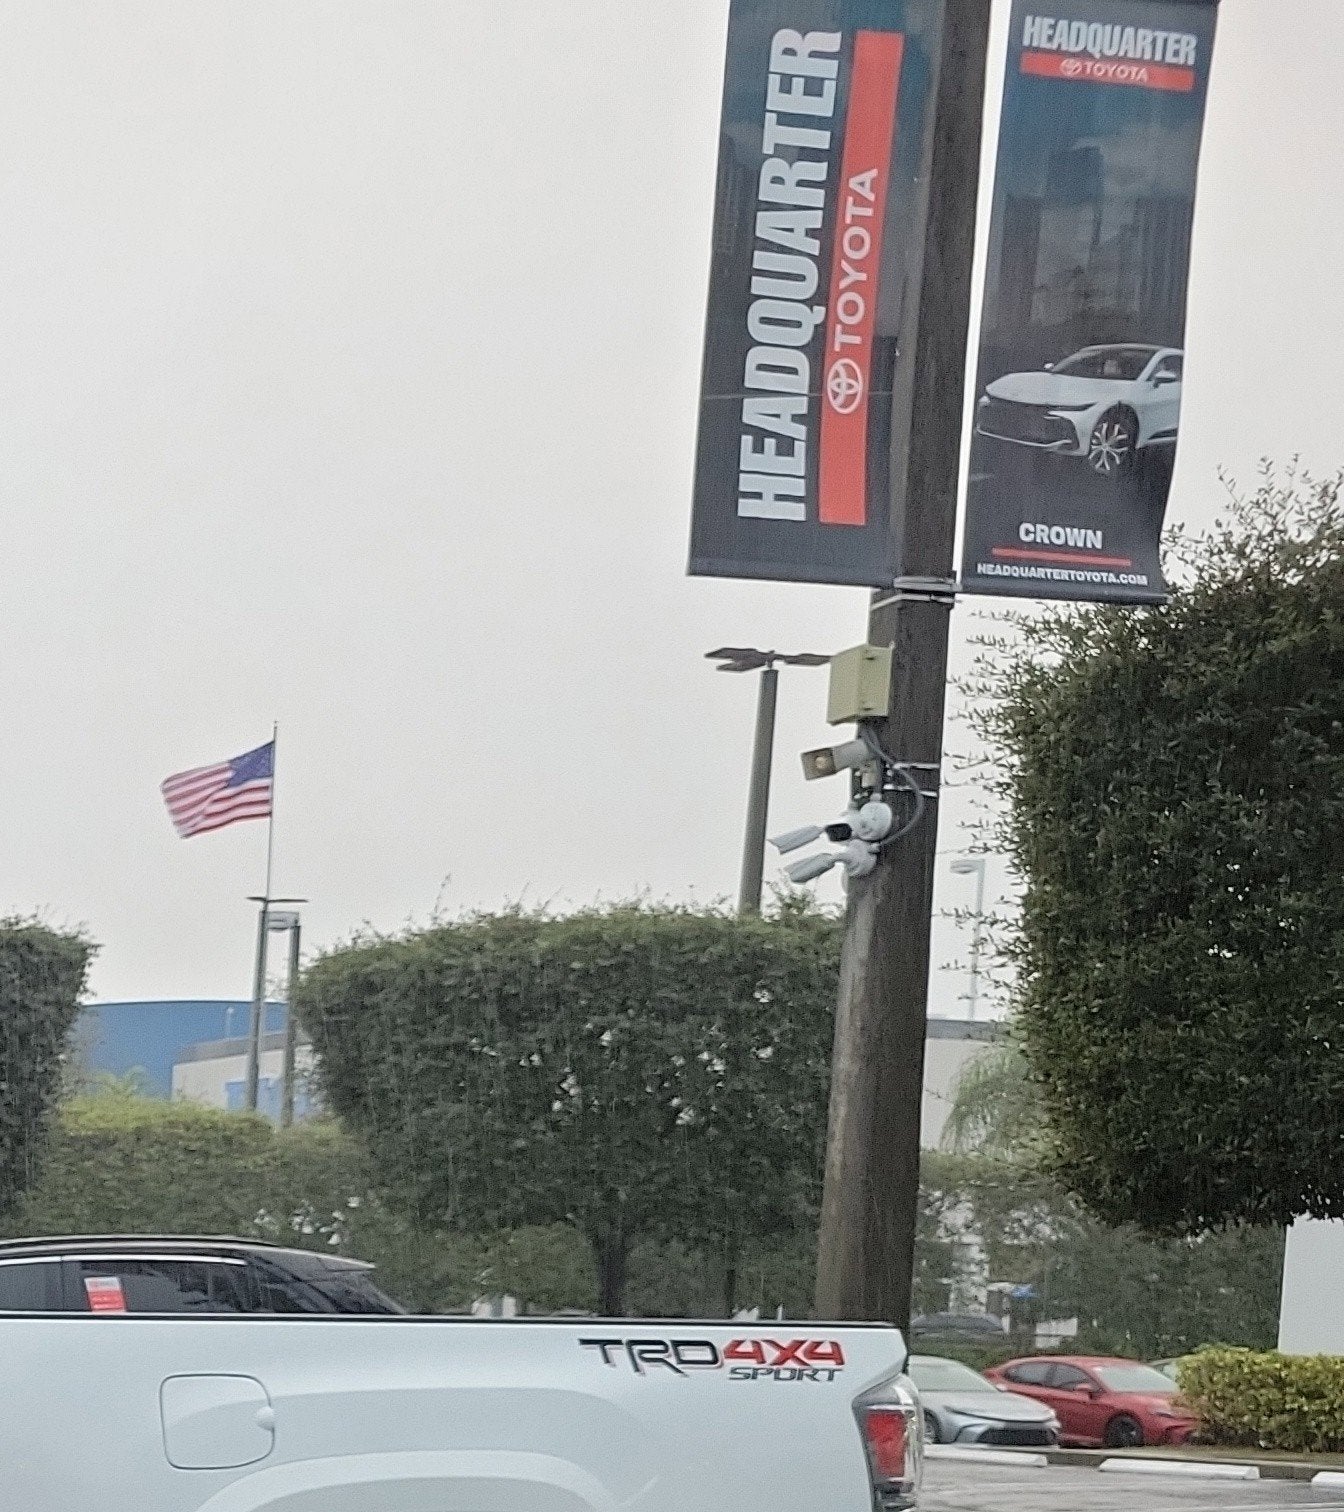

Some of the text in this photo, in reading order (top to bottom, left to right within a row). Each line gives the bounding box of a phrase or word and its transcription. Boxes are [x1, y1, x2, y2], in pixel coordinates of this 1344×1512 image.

[1022, 15, 1197, 66] HEADQUARTER
[1085, 60, 1149, 83] TOYOTA
[738, 28, 842, 521] HEADQUARTER
[834, 168, 878, 352] TOYOTA
[1019, 522, 1103, 549] CROWN
[977, 563, 1148, 586] HEADQUARTERTOYOTA.COM
[579, 1338, 845, 1377] TRD 4X4
[729, 1367, 843, 1382] SPORT
